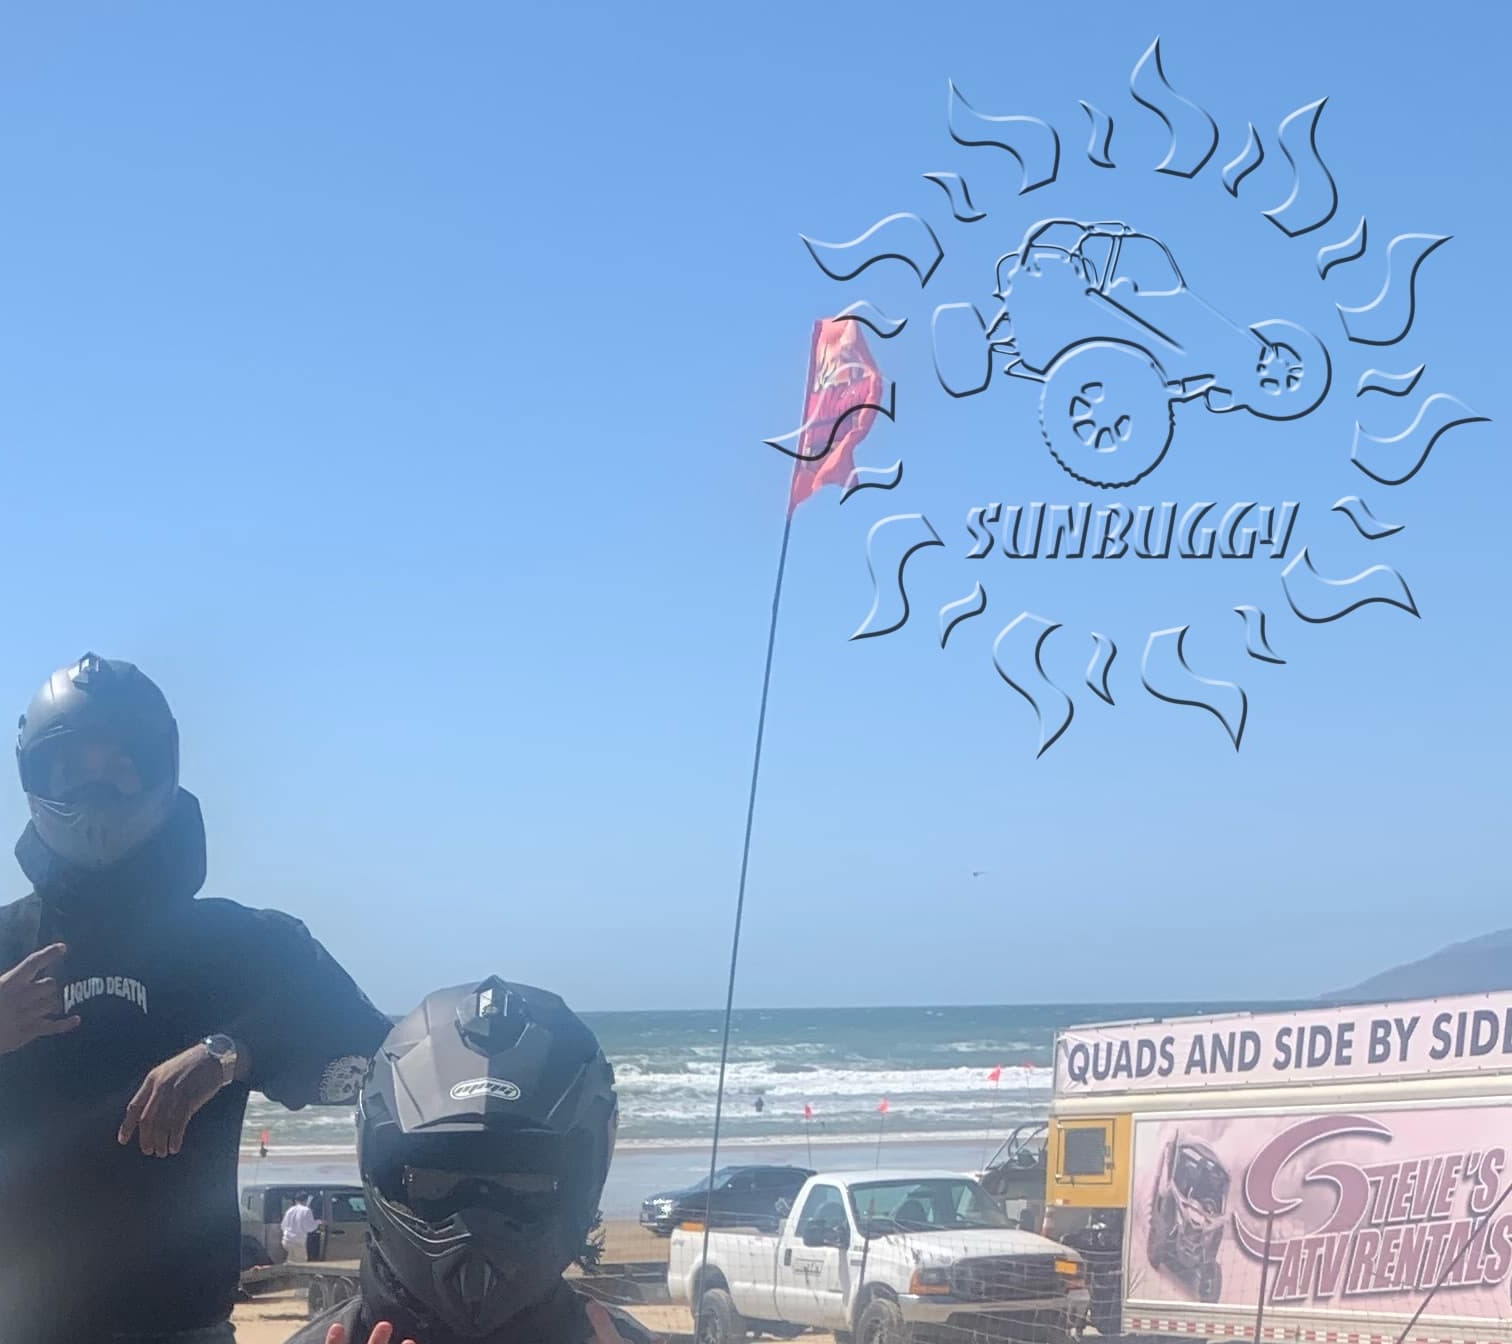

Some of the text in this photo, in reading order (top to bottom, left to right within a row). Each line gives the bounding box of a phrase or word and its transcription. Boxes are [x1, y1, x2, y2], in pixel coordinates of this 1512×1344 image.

[64, 976, 148, 1014] LIQUID DEATH
[1067, 1036, 1176, 1083] QUADS
[1184, 1030, 1261, 1075] AND
[1272, 1022, 1355, 1070] SIDE
[1367, 1015, 1421, 1065] BY
[1272, 1231, 1353, 1300] ATV
